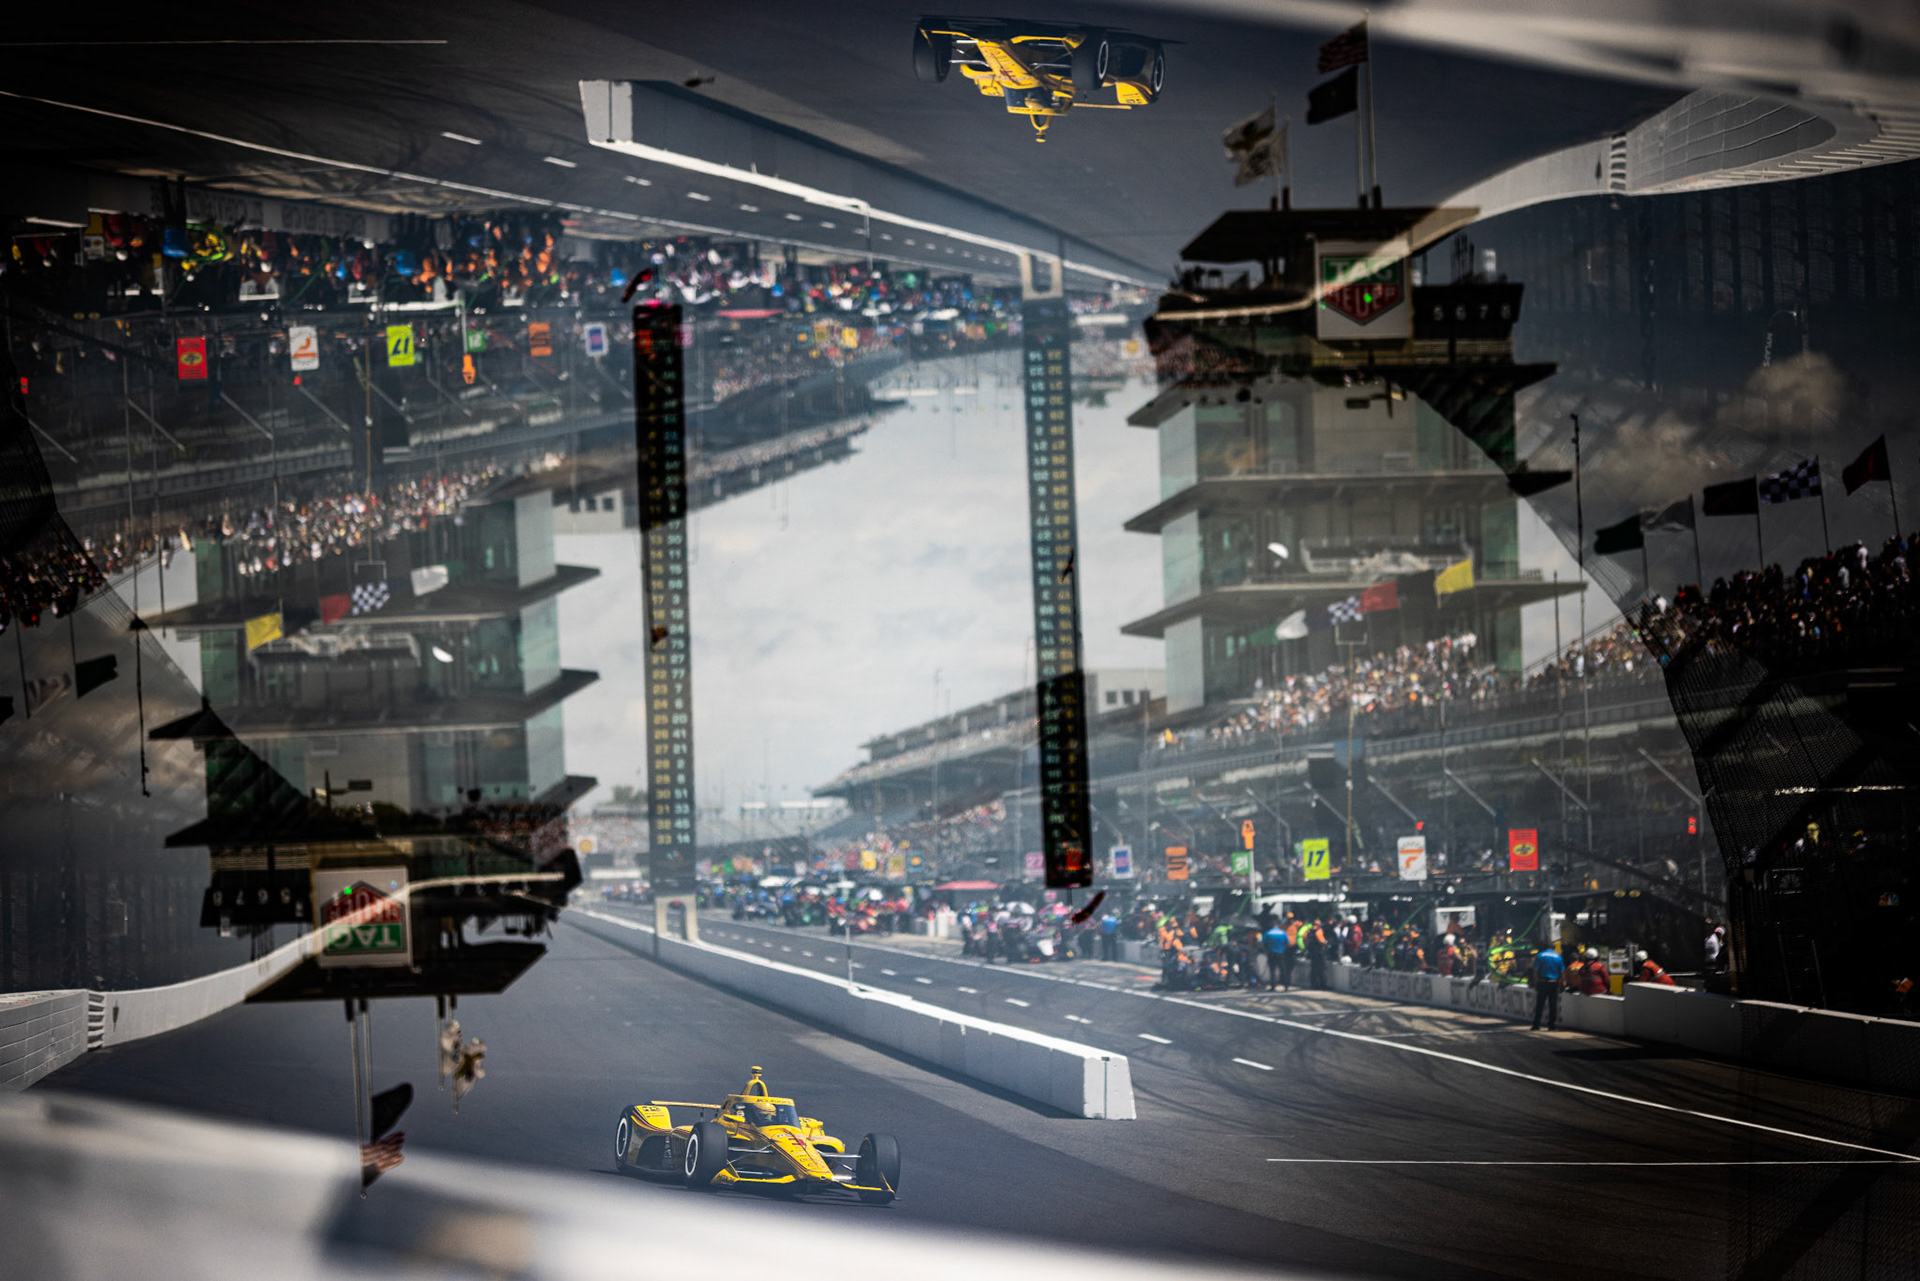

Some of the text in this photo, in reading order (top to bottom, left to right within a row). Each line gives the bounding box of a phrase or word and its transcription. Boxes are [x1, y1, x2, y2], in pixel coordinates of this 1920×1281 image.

[1328, 260, 1394, 281] TAG
[1433, 303, 1512, 321] 5 6 7 8
[391, 338, 410, 356] 17
[1038, 500, 1046, 511] 7
[668, 549, 681, 560] 11
[651, 594, 666, 605] 17
[652, 654, 686, 665] 21 27
[653, 669, 686, 680] 22 77
[653, 684, 683, 695] 23 7
[653, 699, 669, 710] 24
[654, 714, 669, 725] 25
[654, 728, 688, 740] 26 41
[655, 743, 688, 755] 27 21
[655, 759, 671, 770] 28
[655, 774, 671, 785] 29
[656, 789, 671, 800] 30
[656, 804, 672, 814] 31
[657, 818, 672, 829] 32
[657, 833, 673, 844] 33
[1235, 857, 1248, 869] 21
[1308, 850, 1325, 867] 17
[213, 888, 291, 907] 5 6 7 8
[331, 926, 397, 948] TAG
